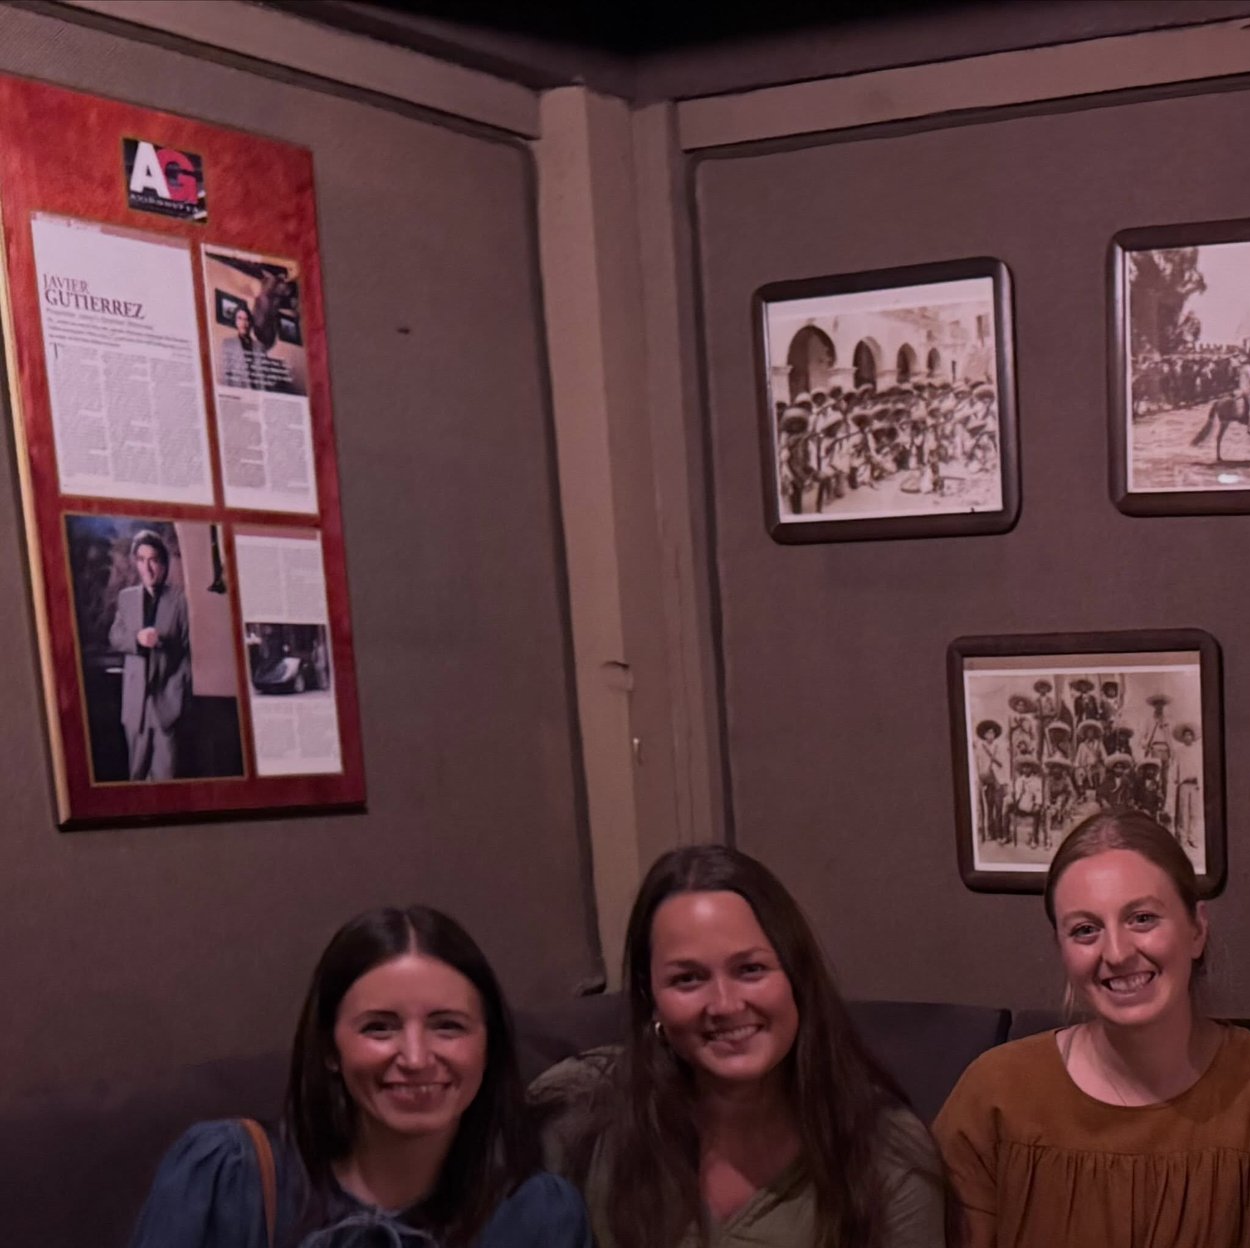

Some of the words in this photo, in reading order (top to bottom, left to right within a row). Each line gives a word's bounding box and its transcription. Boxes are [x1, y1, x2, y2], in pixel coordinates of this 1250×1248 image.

[129, 141, 198, 205] AG
[43, 273, 90, 294] JAVIER
[44, 288, 145, 320] GUTIERREZ
